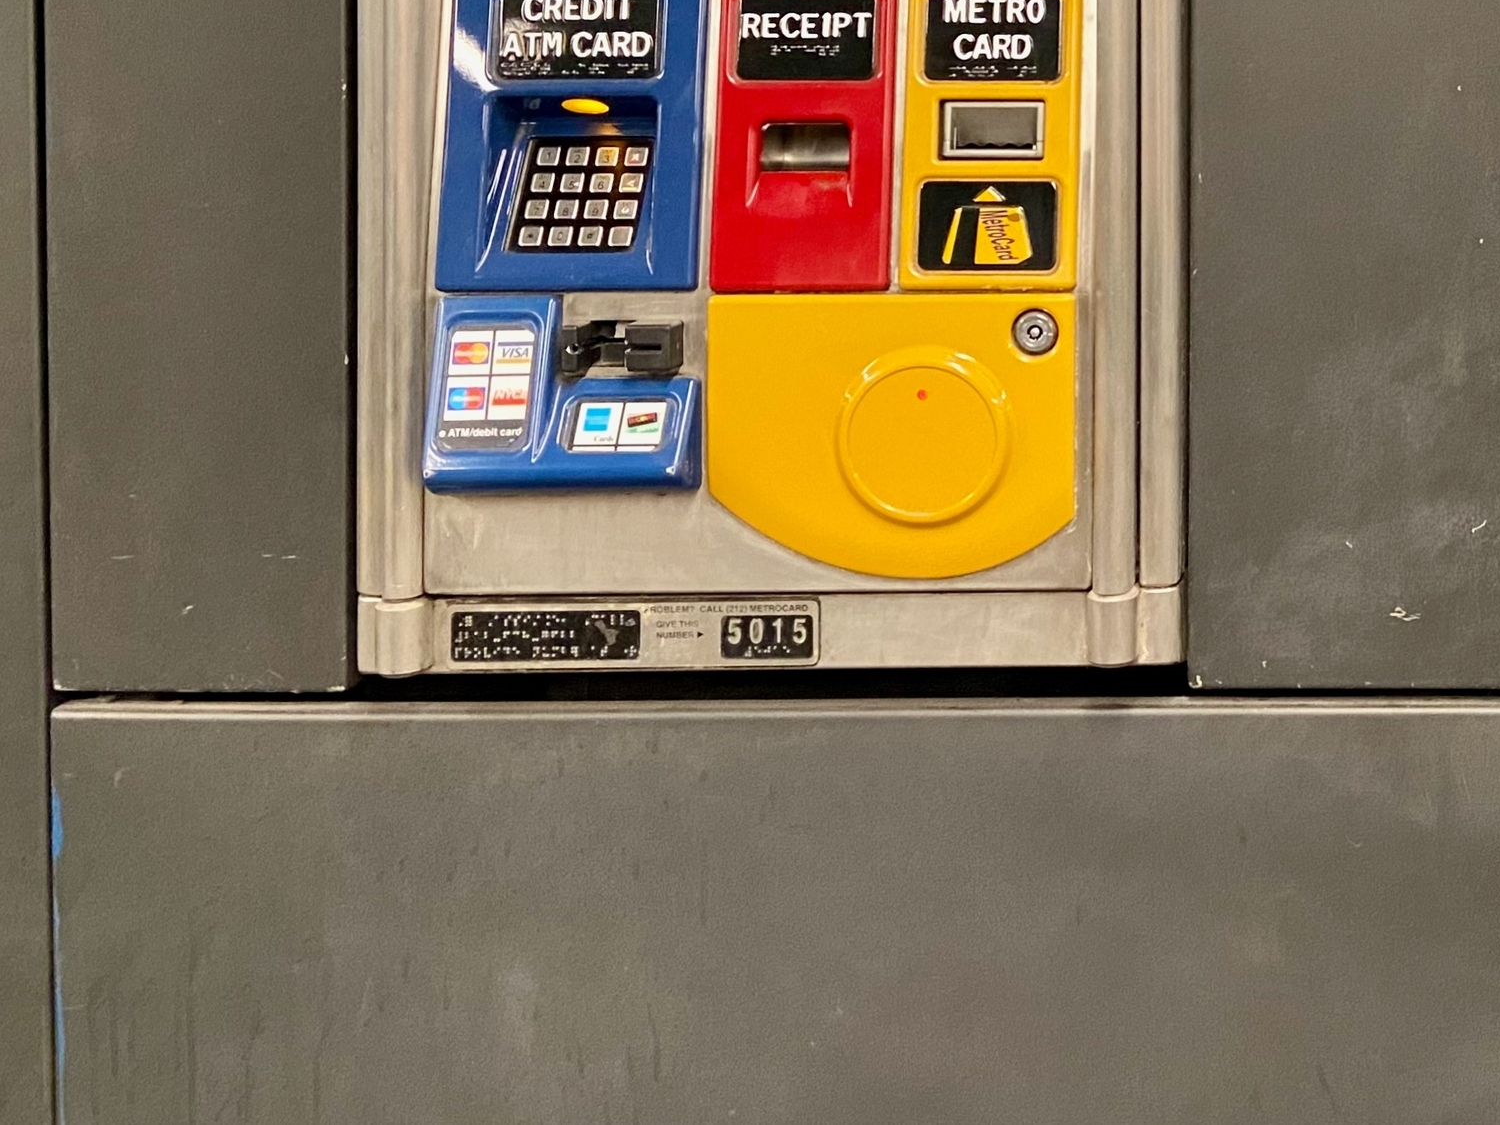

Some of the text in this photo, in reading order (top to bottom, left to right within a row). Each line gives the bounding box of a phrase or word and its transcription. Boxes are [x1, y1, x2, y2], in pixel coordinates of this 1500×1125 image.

[740, 12, 873, 40] RECEIPT
[499, 31, 654, 58] ATM CARD
[952, 34, 1033, 61] CARD
[574, 156, 580, 164] 2
[602, 155, 609, 163] 3
[598, 181, 604, 189] 6
[562, 207, 569, 216] 8
[592, 207, 599, 216] 9
[980, 210, 1019, 260] MetroCard
[502, 347, 529, 358] VISA
[448, 427, 522, 437] ATM/debit card
[645, 605, 694, 613] ROBLEM?
[726, 604, 748, 614] (212)
[656, 620, 677, 628] GIVE
[656, 631, 694, 639] NUMBER
[728, 618, 807, 644] 5015
